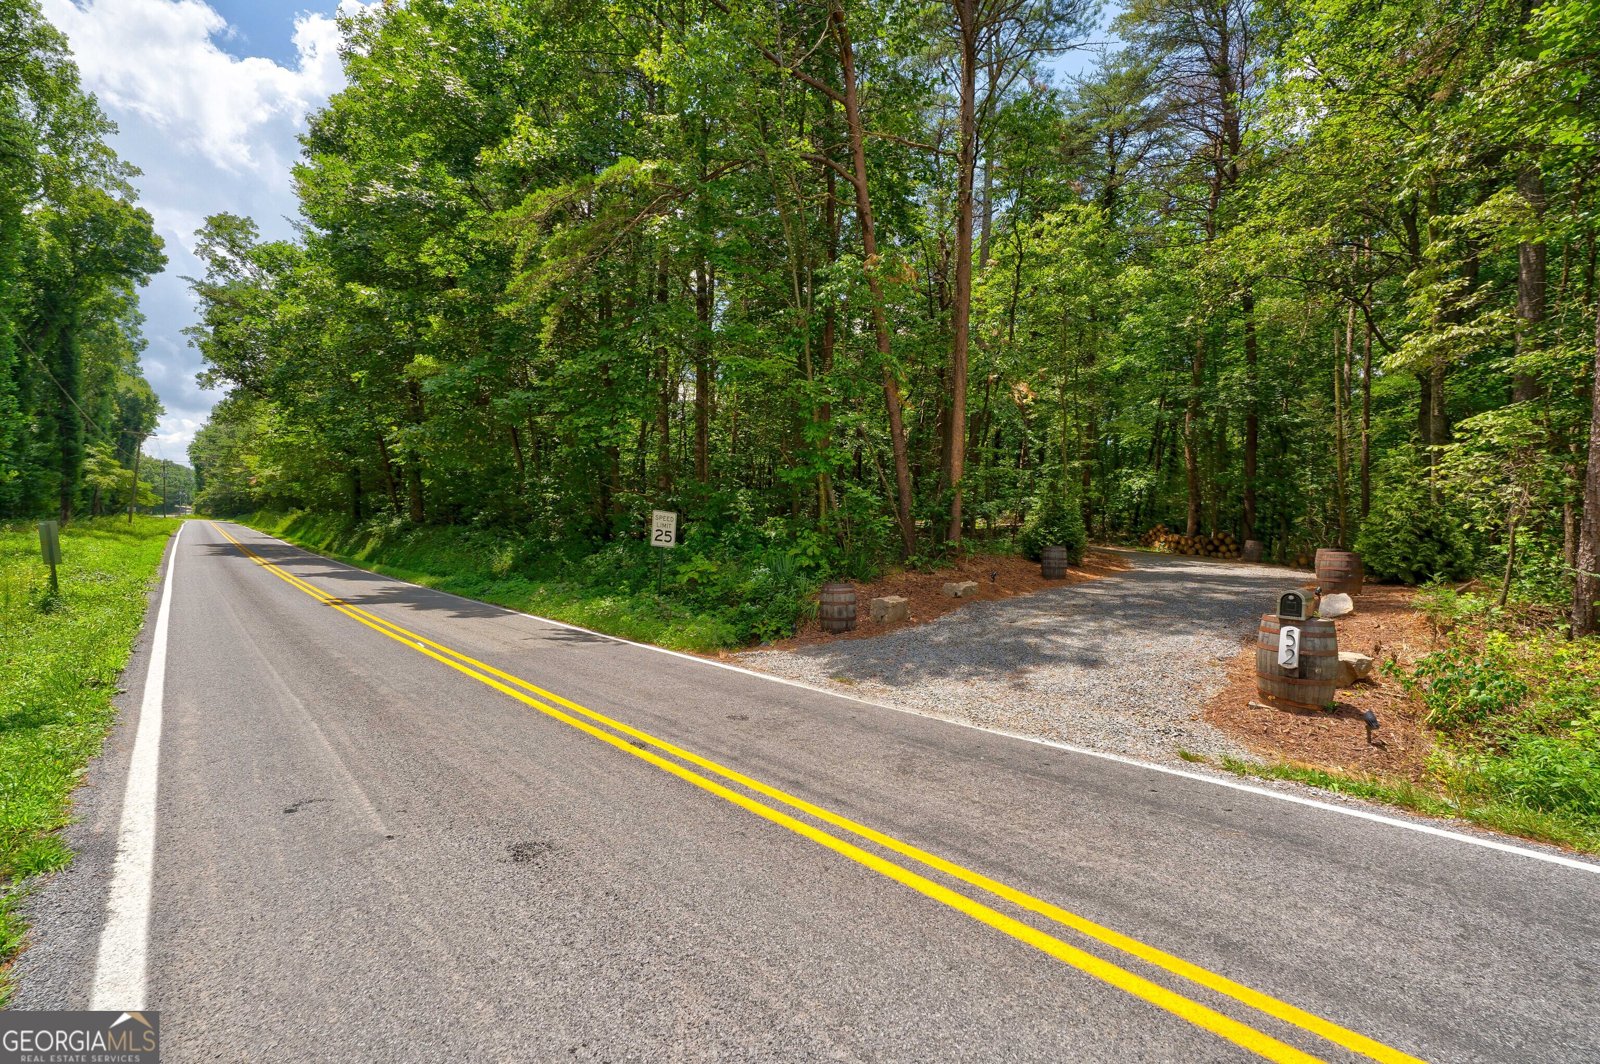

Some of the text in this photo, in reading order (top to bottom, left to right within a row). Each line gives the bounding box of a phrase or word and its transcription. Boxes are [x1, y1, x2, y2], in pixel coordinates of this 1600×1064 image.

[654, 514, 674, 522] SPEED
[654, 529, 672, 543] 25
[1282, 629, 1297, 665] 52
